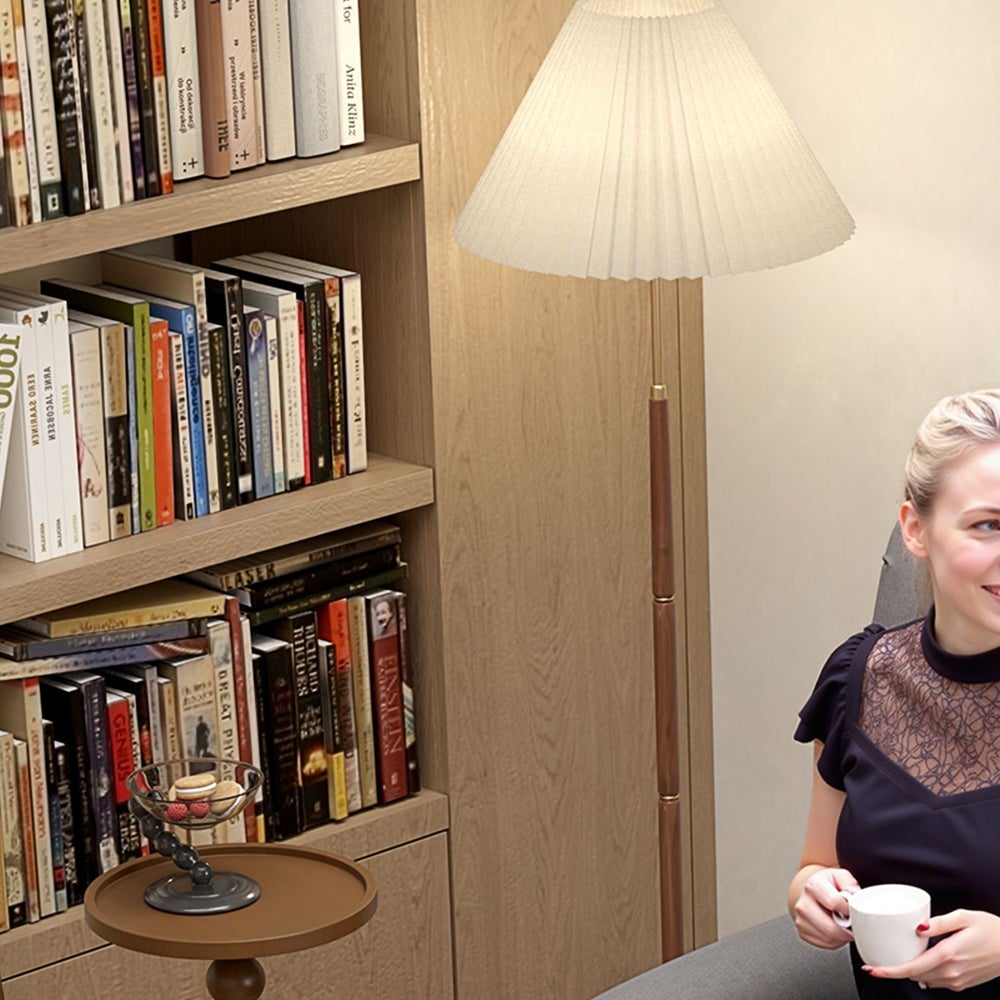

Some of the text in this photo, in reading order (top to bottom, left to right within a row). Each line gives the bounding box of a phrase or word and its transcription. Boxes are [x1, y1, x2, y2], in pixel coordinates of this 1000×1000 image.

[343, 6, 353, 24] for
[345, 64, 358, 137] Anita Klinz
[225, 563, 277, 590] LASER
[294, 625, 309, 697] RHODES
[305, 624, 319, 694] RICHARD
[218, 670, 232, 721] GREAT
[384, 656, 402, 754] EINSTEIN
[113, 713, 131, 783] GENIUS
